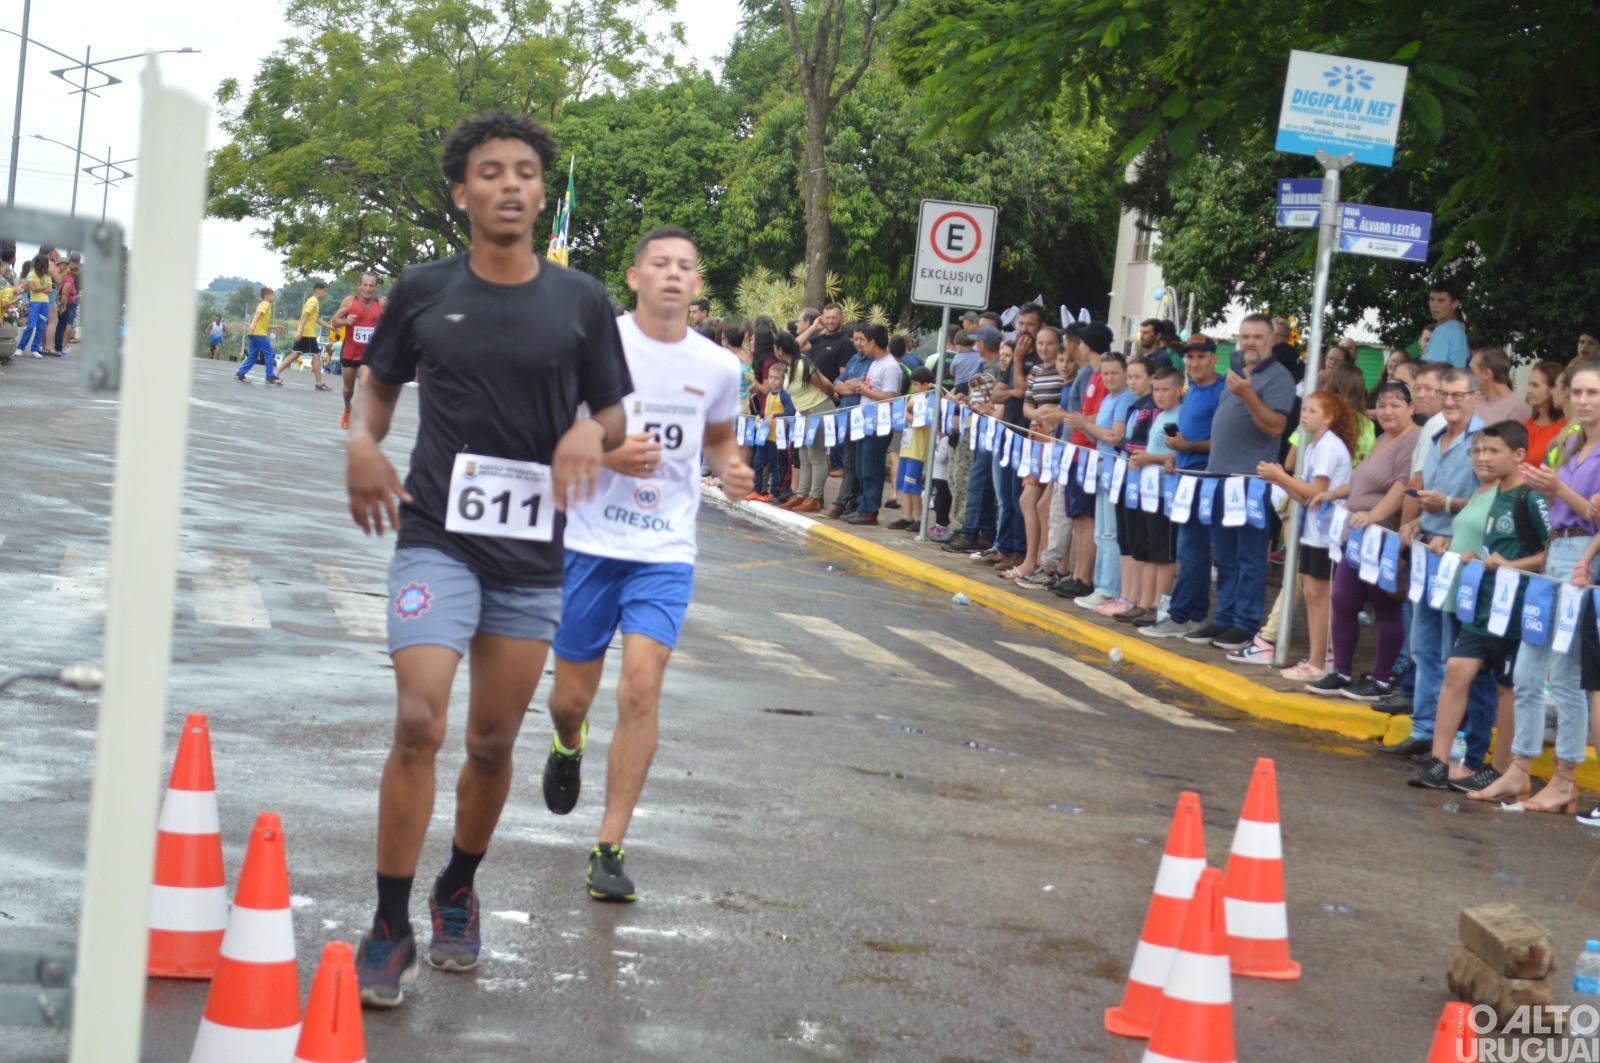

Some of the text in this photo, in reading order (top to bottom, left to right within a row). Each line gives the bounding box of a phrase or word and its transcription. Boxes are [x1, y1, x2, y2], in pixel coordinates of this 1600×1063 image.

[1289, 104, 1325, 116] PROVEDOR
[1325, 109, 1346, 119] LEGAL
[1357, 115, 1391, 126] INTERNET
[1291, 88, 1397, 119] DIGIPLAN NET
[1344, 206, 1360, 217] RUA
[946, 223, 966, 251] E
[1342, 217, 1422, 239] DR. ÁLVARO LEITÃO
[920, 267, 983, 284] EXCLUSIVO
[938, 282, 964, 296] TÁXI
[643, 422, 684, 451] 59
[457, 485, 542, 527] 611
[603, 503, 676, 533] CRESOL
[1536, 498, 1552, 532] HAVA
